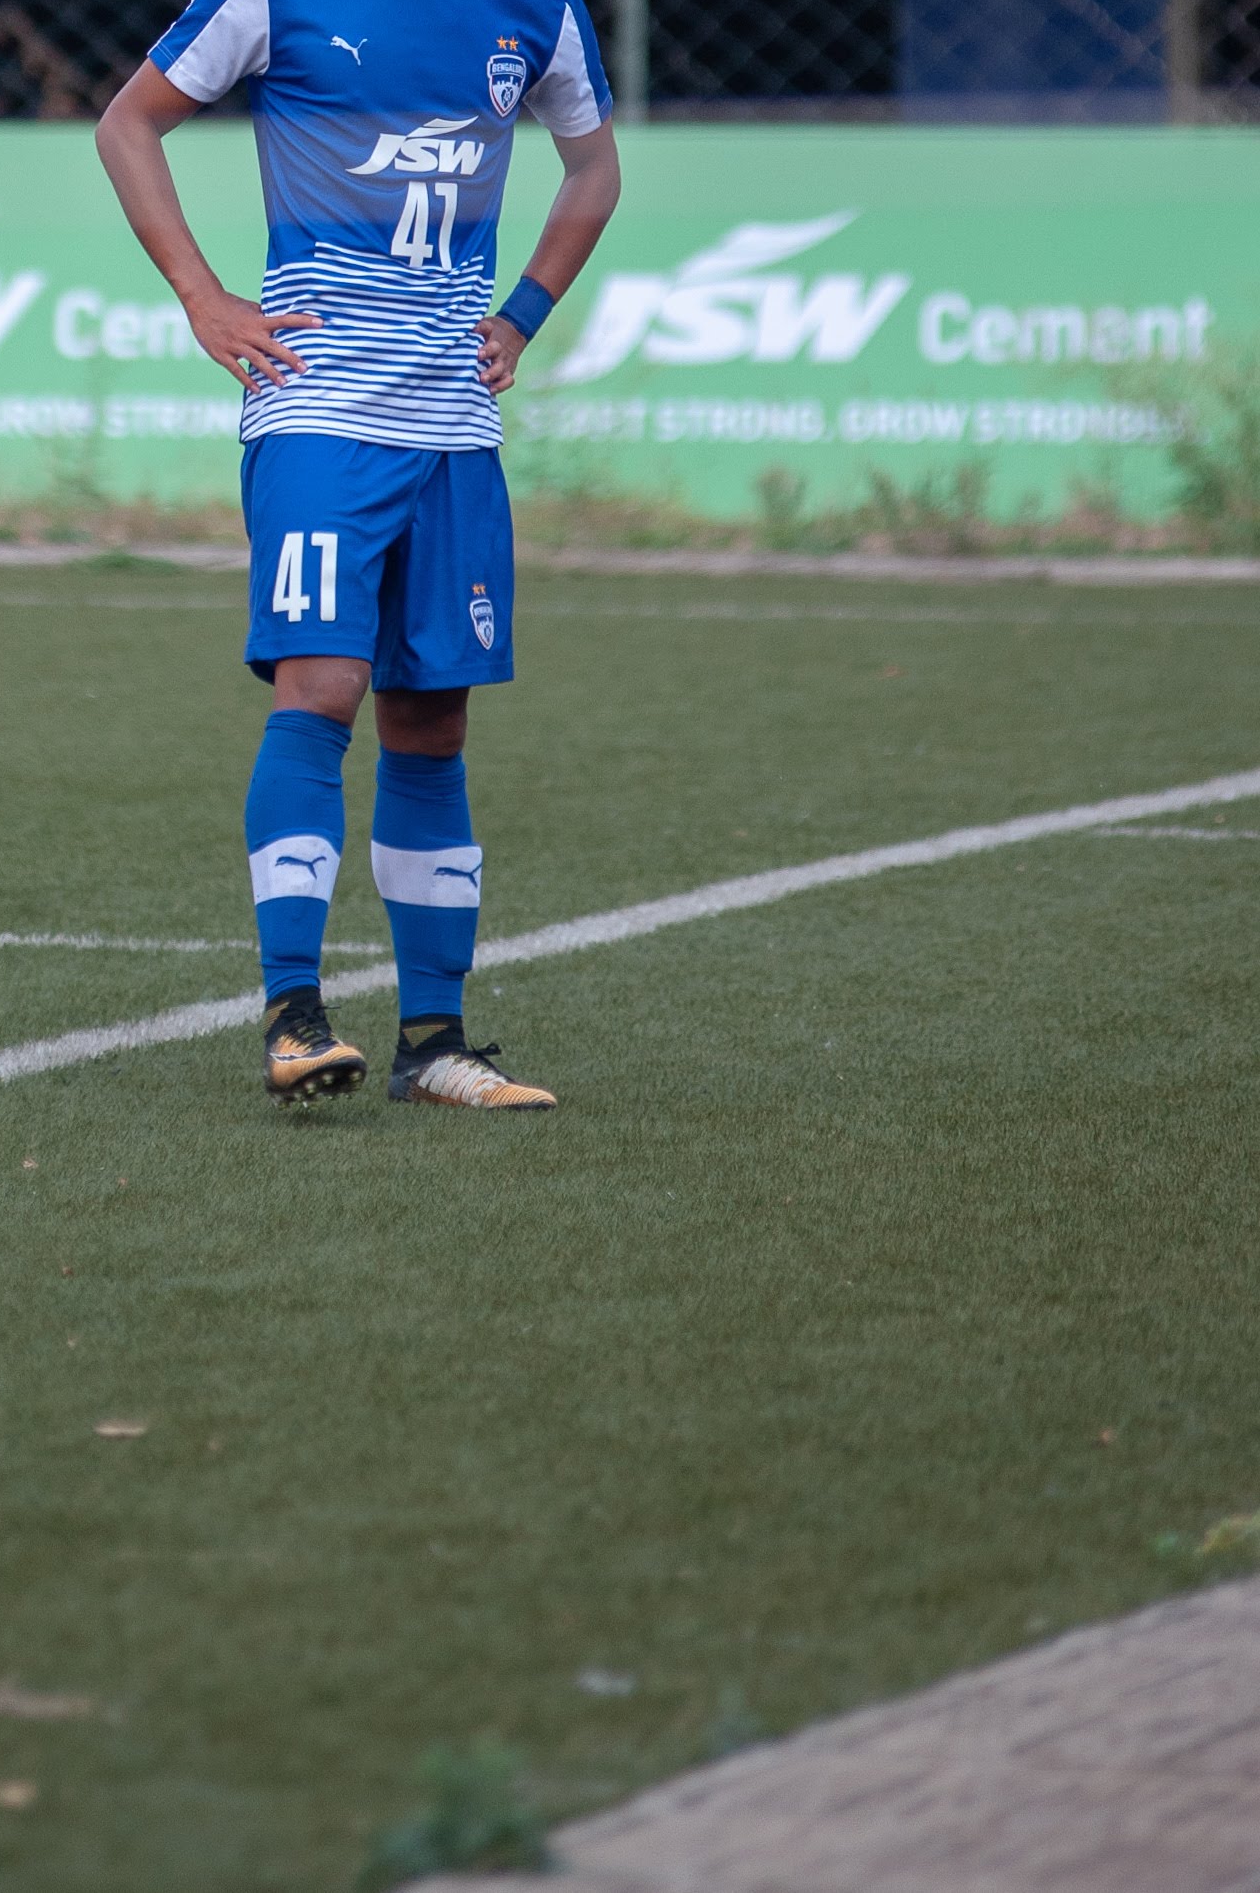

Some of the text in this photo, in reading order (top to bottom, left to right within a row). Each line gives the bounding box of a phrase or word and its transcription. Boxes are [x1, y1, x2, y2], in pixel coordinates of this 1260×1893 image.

[345, 132, 485, 176] JSW
[391, 181, 458, 272] 41
[54, 289, 208, 360] Cem
[540, 271, 1213, 388] JSW Cement
[272, 532, 338, 622] 41
